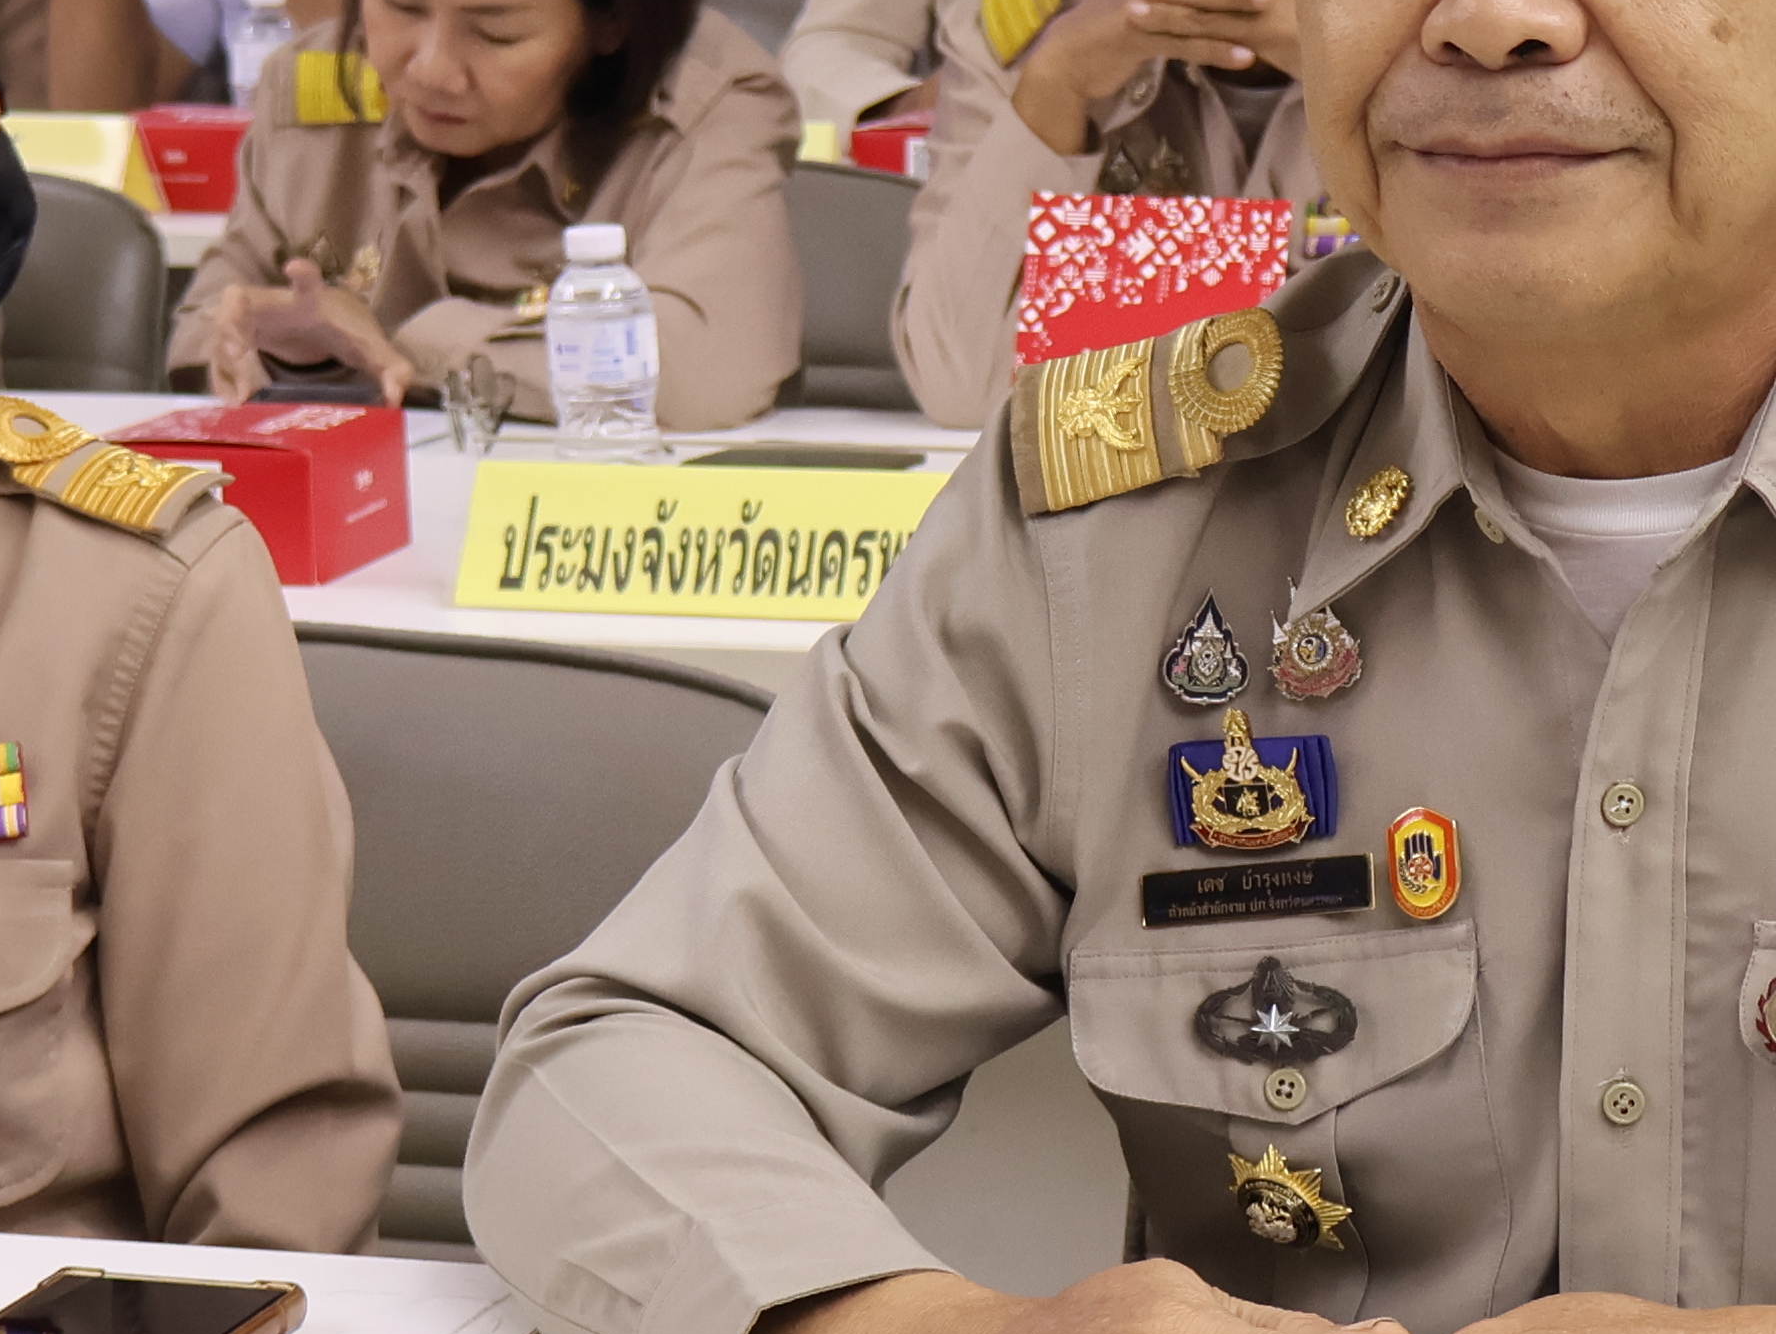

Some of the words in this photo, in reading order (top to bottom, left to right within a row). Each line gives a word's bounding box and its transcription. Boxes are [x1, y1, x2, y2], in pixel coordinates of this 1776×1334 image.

[499, 494, 912, 597] ประมงจังหวัดนครพ
